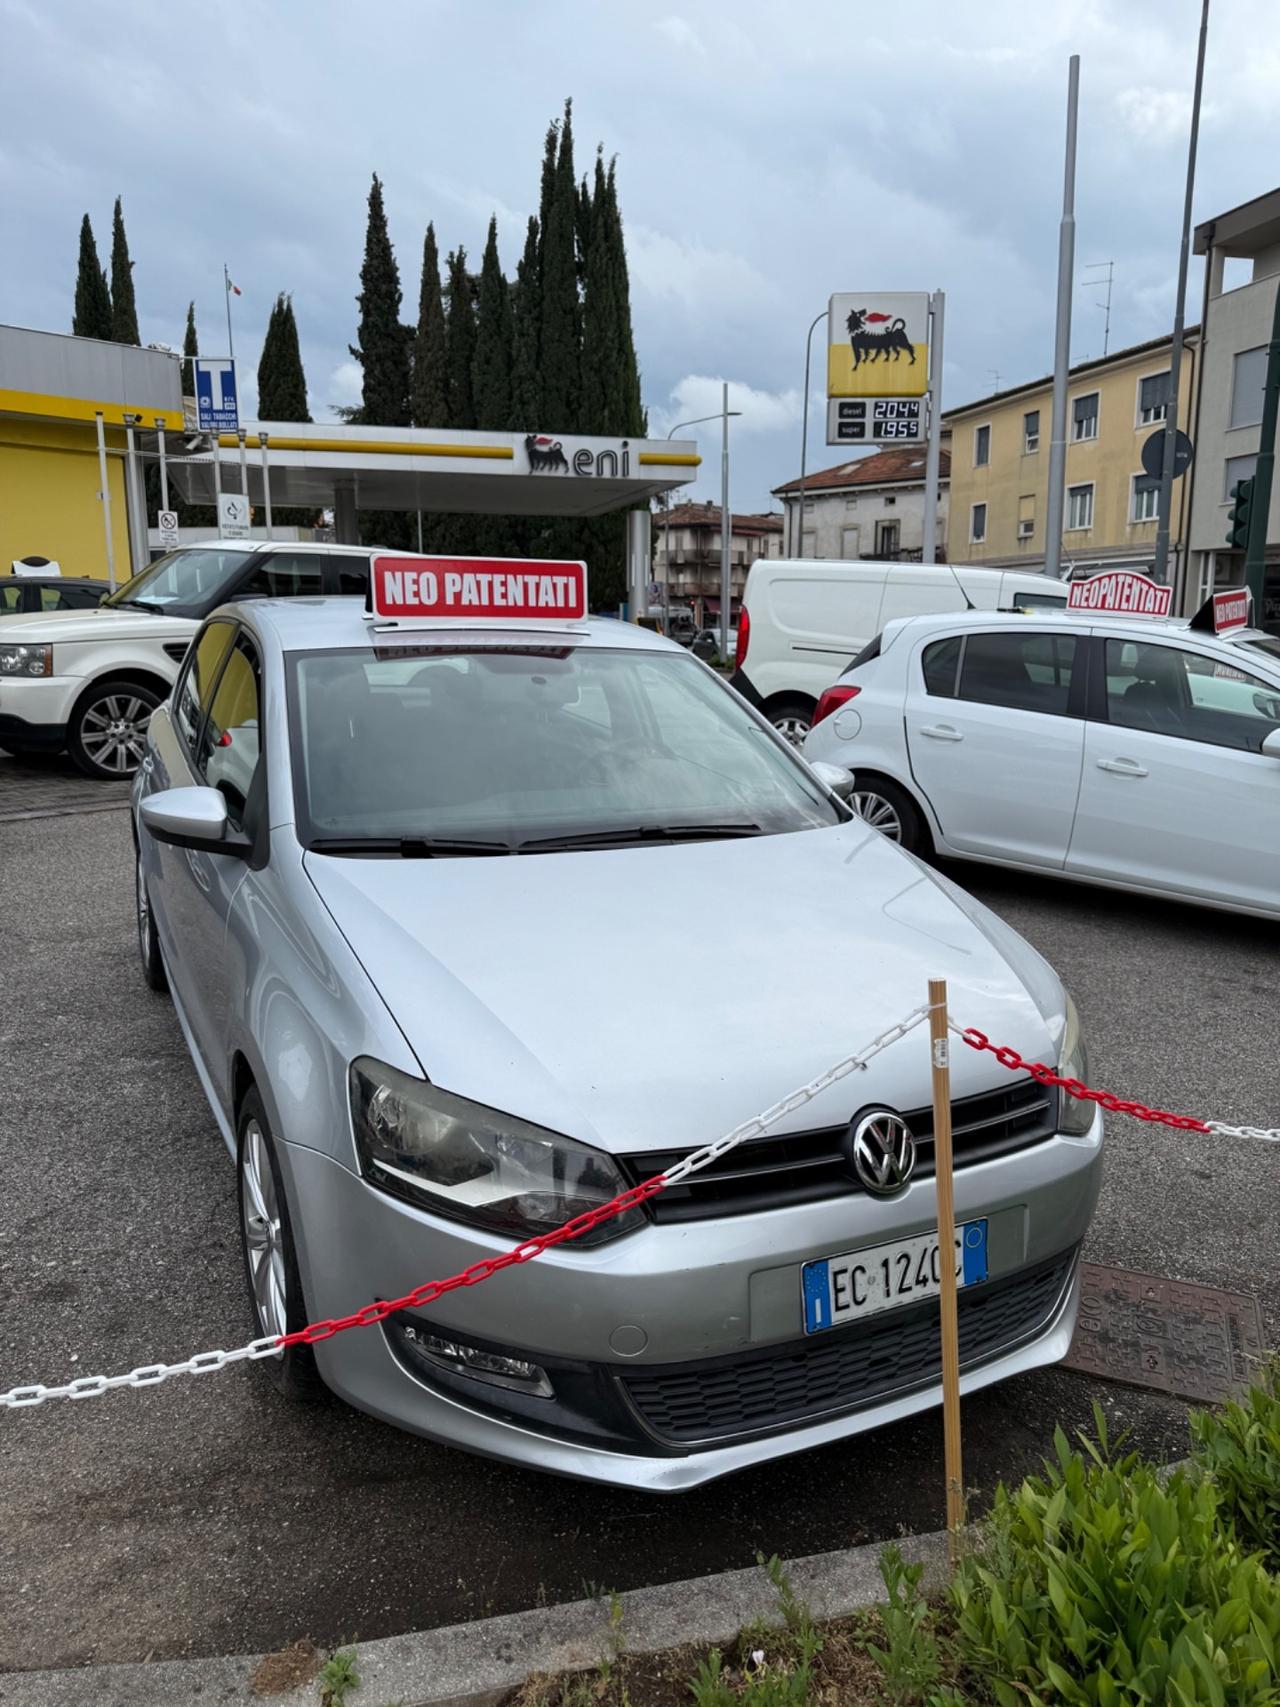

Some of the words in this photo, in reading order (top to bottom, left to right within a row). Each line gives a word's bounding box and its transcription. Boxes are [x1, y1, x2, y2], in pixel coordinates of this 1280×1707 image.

[199, 360, 233, 411] T
[573, 440, 629, 478] eni
[384, 571, 438, 606] NEO
[444, 572, 577, 608] PATENTATI
[1072, 574, 1169, 614] NEOPATENTATI
[832, 1265, 867, 1312] EC
